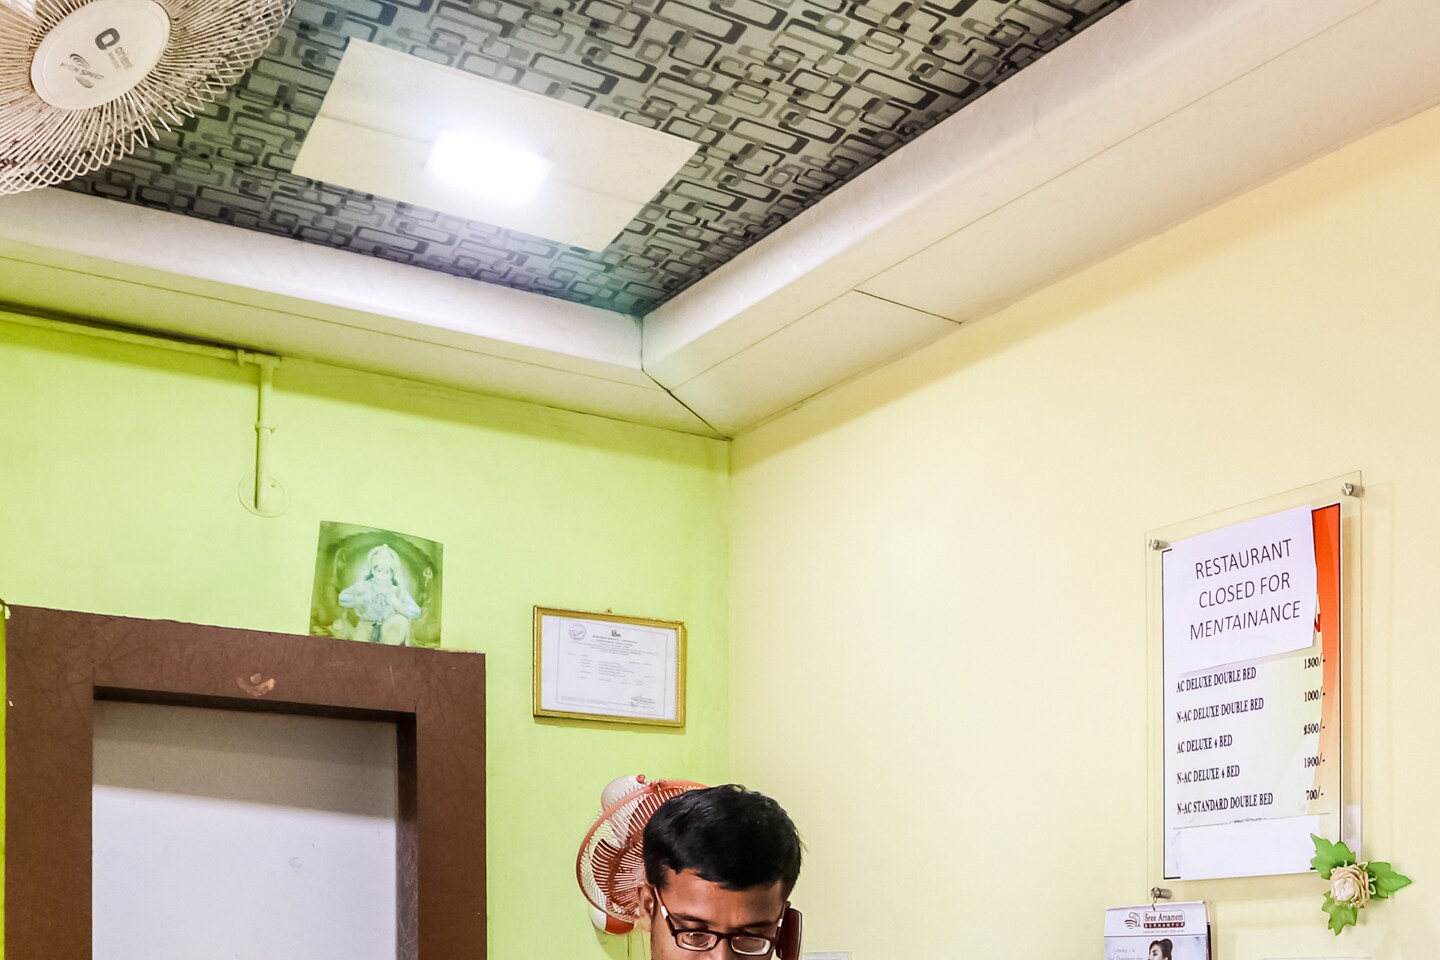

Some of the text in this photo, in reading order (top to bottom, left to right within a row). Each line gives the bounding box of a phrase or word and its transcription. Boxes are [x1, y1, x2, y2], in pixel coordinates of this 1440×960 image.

[1195, 538, 1292, 580] RESTAURANT
[1198, 571, 1291, 609] CLOSED FOR
[1189, 600, 1301, 641] MENTAINANCE
[1176, 680, 1185, 693] AC
[1186, 675, 1212, 691] DELUXE
[1213, 669, 1241, 686] DOUBLE
[1242, 666, 1257, 681] BED
[1176, 709, 1192, 723] N-AC
[1193, 704, 1220, 720] DELUXE
[1221, 699, 1249, 716] DOUBLE
[1250, 697, 1265, 711] BED
[1176, 741, 1185, 754] AC
[1186, 737, 1213, 752] DELUXE
[1219, 734, 1233, 748] BED
[1176, 771, 1192, 784] N-AC
[1193, 767, 1220, 782] DELUXE
[1226, 764, 1240, 778] BED
[1176, 801, 1192, 815] N-AC
[1193, 797, 1229, 813] STANDARD
[1230, 793, 1258, 809] DOUBLE
[1259, 792, 1274, 806] BED
